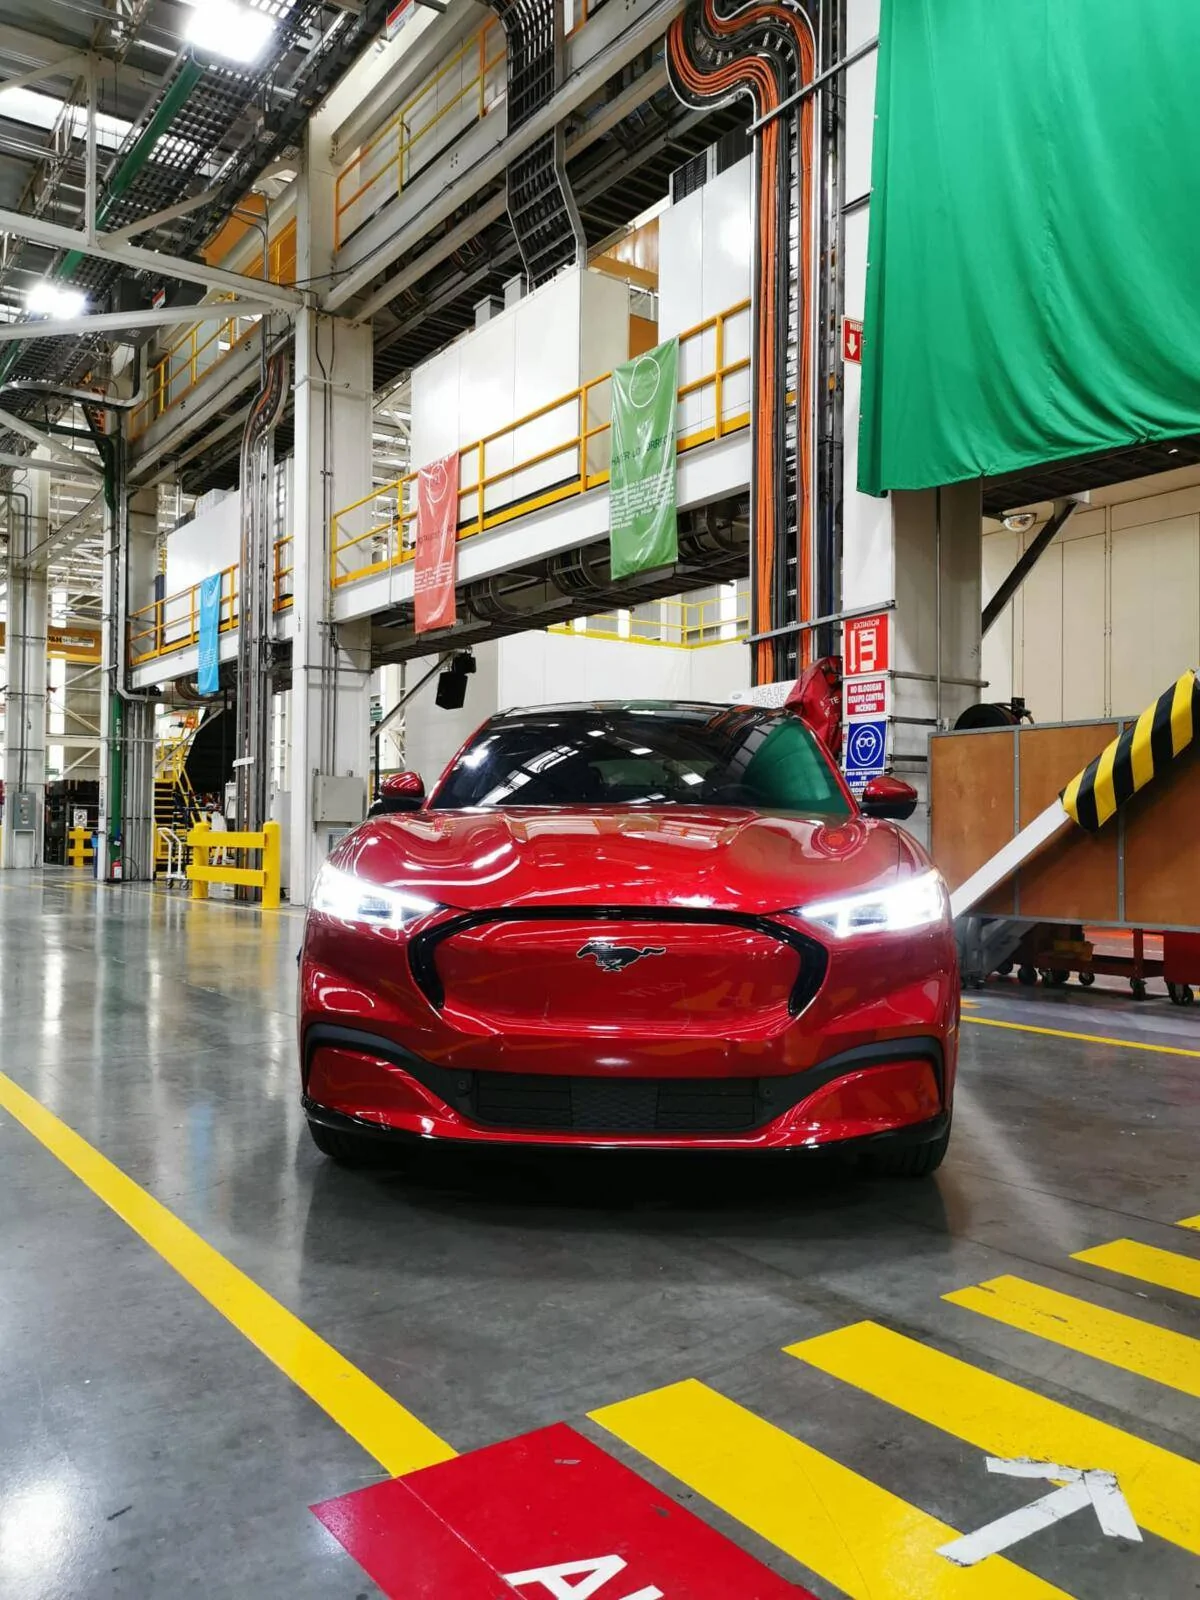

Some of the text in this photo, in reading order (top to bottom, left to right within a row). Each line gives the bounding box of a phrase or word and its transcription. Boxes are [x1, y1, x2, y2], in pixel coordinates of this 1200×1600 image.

[853, 619, 880, 630] EXTINTOR
[850, 683, 882, 694] NO BLOQUEAR
[848, 692, 884, 704] EQUIPO CONTRA
